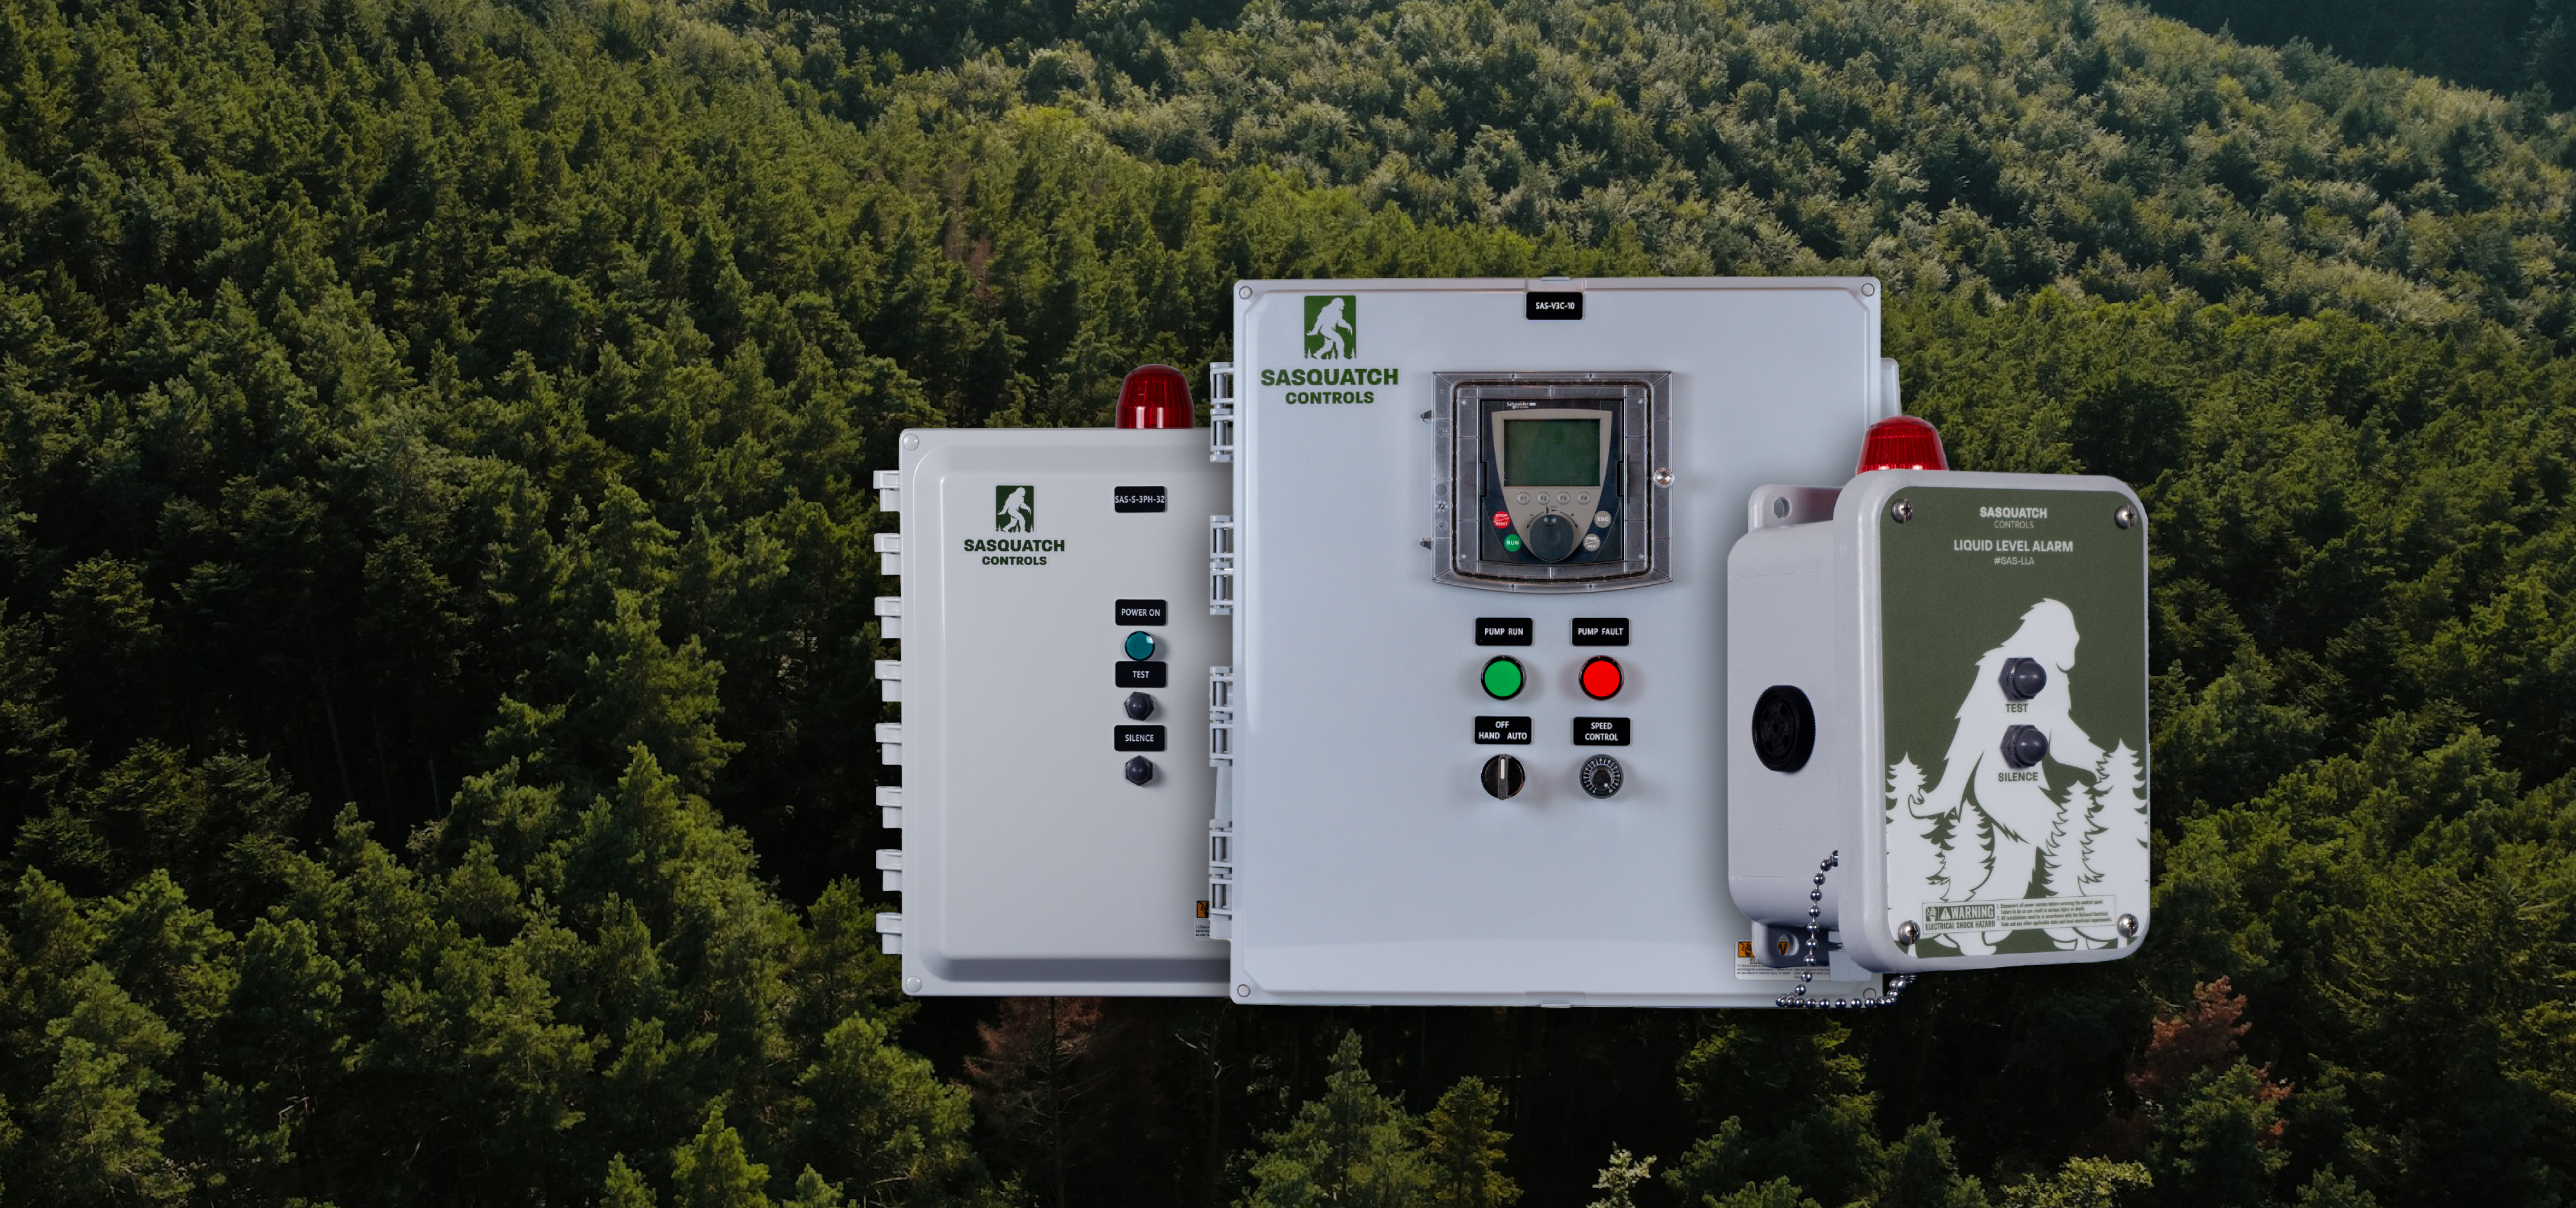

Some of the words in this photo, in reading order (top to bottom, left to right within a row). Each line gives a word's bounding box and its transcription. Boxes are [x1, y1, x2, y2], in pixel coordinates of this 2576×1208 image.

[1535, 302, 1575, 310] SAS-V3C-10
[1260, 368, 1398, 386] SASQUATCH
[1285, 391, 1374, 405] CONTROLS
[1115, 495, 1165, 504] SAS-S-3PH-32
[1979, 506, 2048, 519] SASQUATCH
[1994, 521, 2034, 529] CONTROLS
[963, 539, 1065, 552] SASQUATCH
[1954, 539, 1993, 551] LIQUID
[1996, 540, 2031, 551] LEVEL
[2032, 541, 2074, 552] ALARM
[982, 556, 1047, 566] CONTROLS
[1994, 557, 2035, 566] #SAS-LLA
[1121, 608, 1147, 617] POWER
[2005, 704, 2028, 713] TEST
[1125, 734, 1154, 742] SILENCE
[1998, 772, 2038, 782] SILENCE
[1951, 905, 1994, 919] WARNING
[1926, 922, 1955, 930] ELECTRICAL
